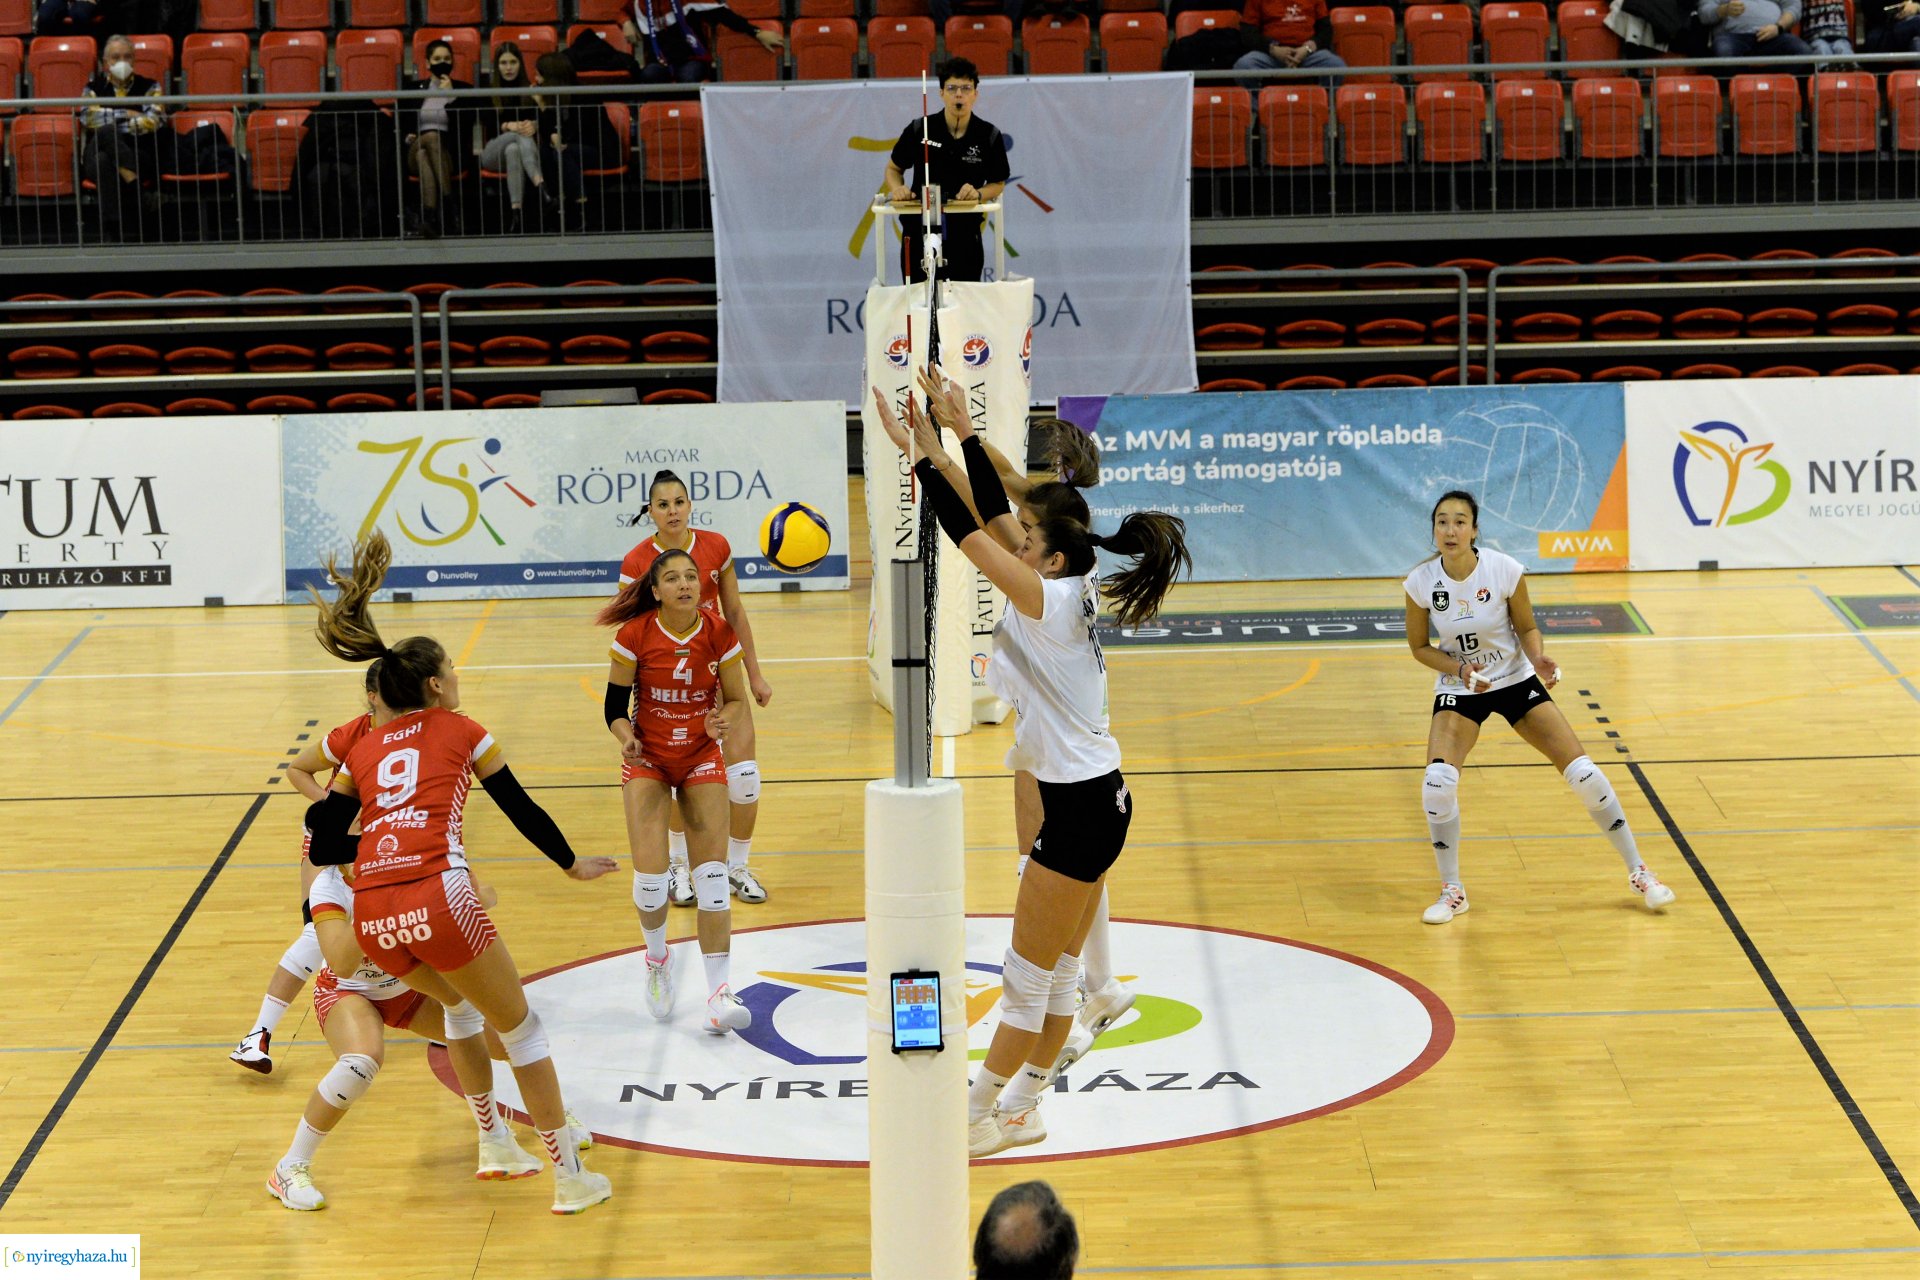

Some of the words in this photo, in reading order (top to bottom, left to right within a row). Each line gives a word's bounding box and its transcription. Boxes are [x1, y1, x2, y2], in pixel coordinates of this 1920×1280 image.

[1125, 429, 1191, 450] MVM
[1200, 433, 1215, 449] a
[1223, 430, 1319, 452] magyar
[1327, 424, 1442, 449] röplabda
[625, 448, 700, 464] MAGYAR
[1099, 458, 1186, 485] portág
[1193, 455, 1342, 483] támogatója
[1808, 449, 1918, 494] NYÍR
[557, 467, 773, 505] RÖPLBDA
[1182, 505, 1191, 514] a
[1193, 502, 1246, 514] sikerhez
[1809, 503, 1871, 518] MEGYEI
[1551, 536, 1613, 553] MVM
[2, 568, 104, 586] RUHÁZÓ
[122, 570, 166, 583] KFT
[440, 571, 479, 581] hunvolley
[537, 568, 608, 578] www.hunvolley.hu
[1455, 632, 1479, 652] 15
[672, 657, 693, 685] 4
[1438, 694, 1457, 707] 15
[382, 721, 422, 745] EGRI
[375, 747, 419, 809] 9
[686, 769, 722, 780] SEAT
[390, 821, 427, 830] TYRES
[360, 854, 422, 872] SZABADICS
[361, 916, 397, 938] PEKA
[399, 906, 429, 928] BAU
[377, 923, 433, 951] 000
